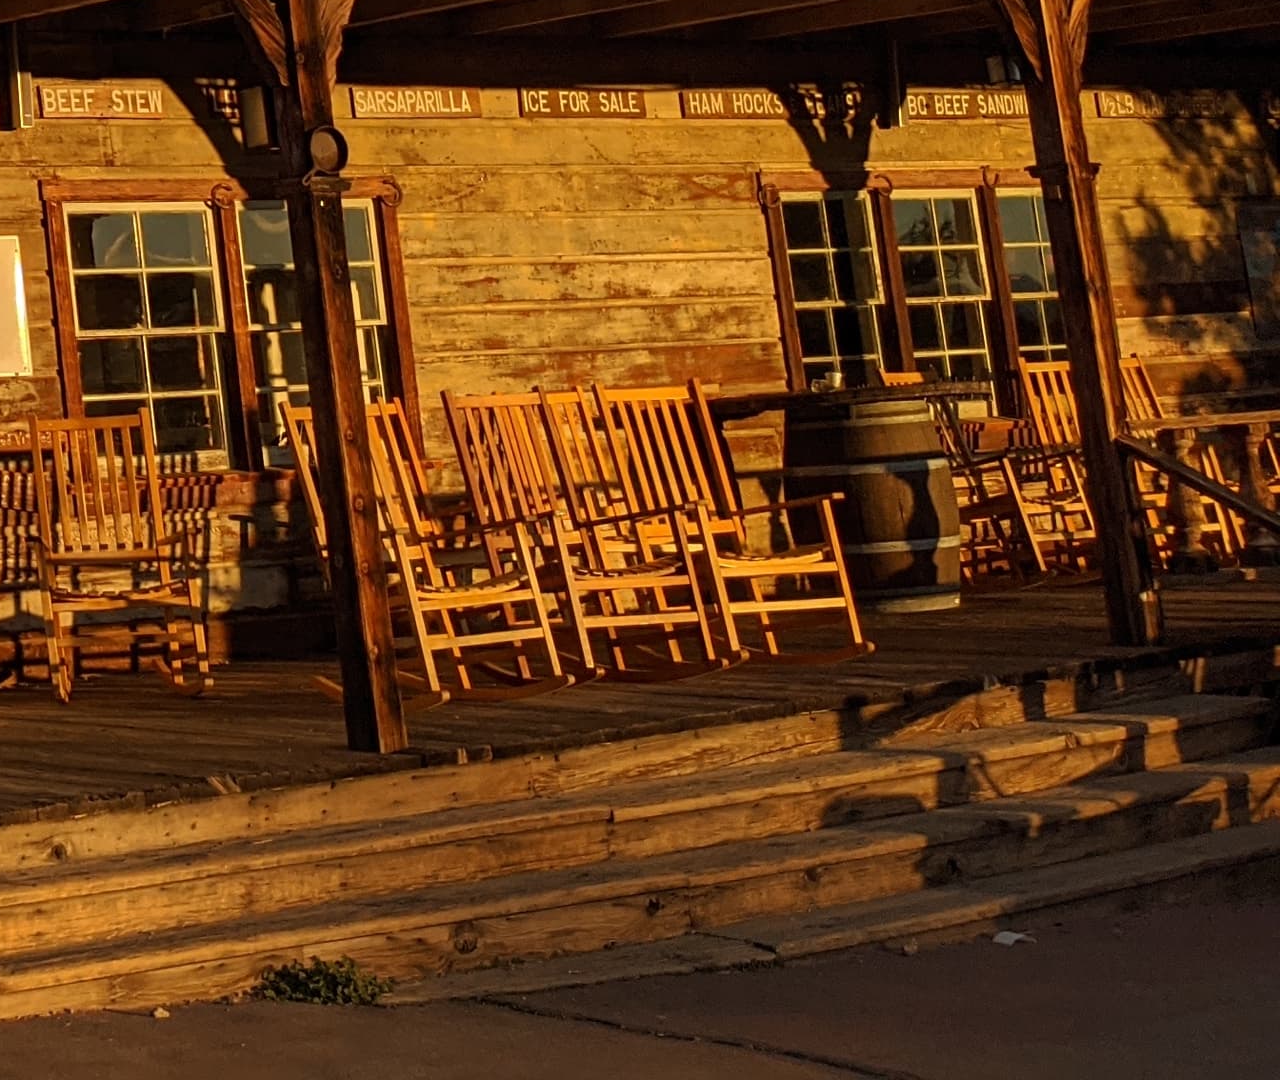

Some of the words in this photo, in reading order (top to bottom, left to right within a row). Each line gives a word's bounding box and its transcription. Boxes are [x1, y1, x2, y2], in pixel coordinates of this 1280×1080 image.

[42, 88, 95, 114] BEEF
[111, 89, 163, 114] STEW
[354, 88, 472, 114] SARSAPARILLA
[523, 88, 551, 114] ICE
[559, 88, 590, 114] FOR
[598, 88, 641, 114] SALE
[689, 92, 724, 115] HAM
[733, 92, 785, 115] HOCKS
[934, 94, 970, 115] BEEF
